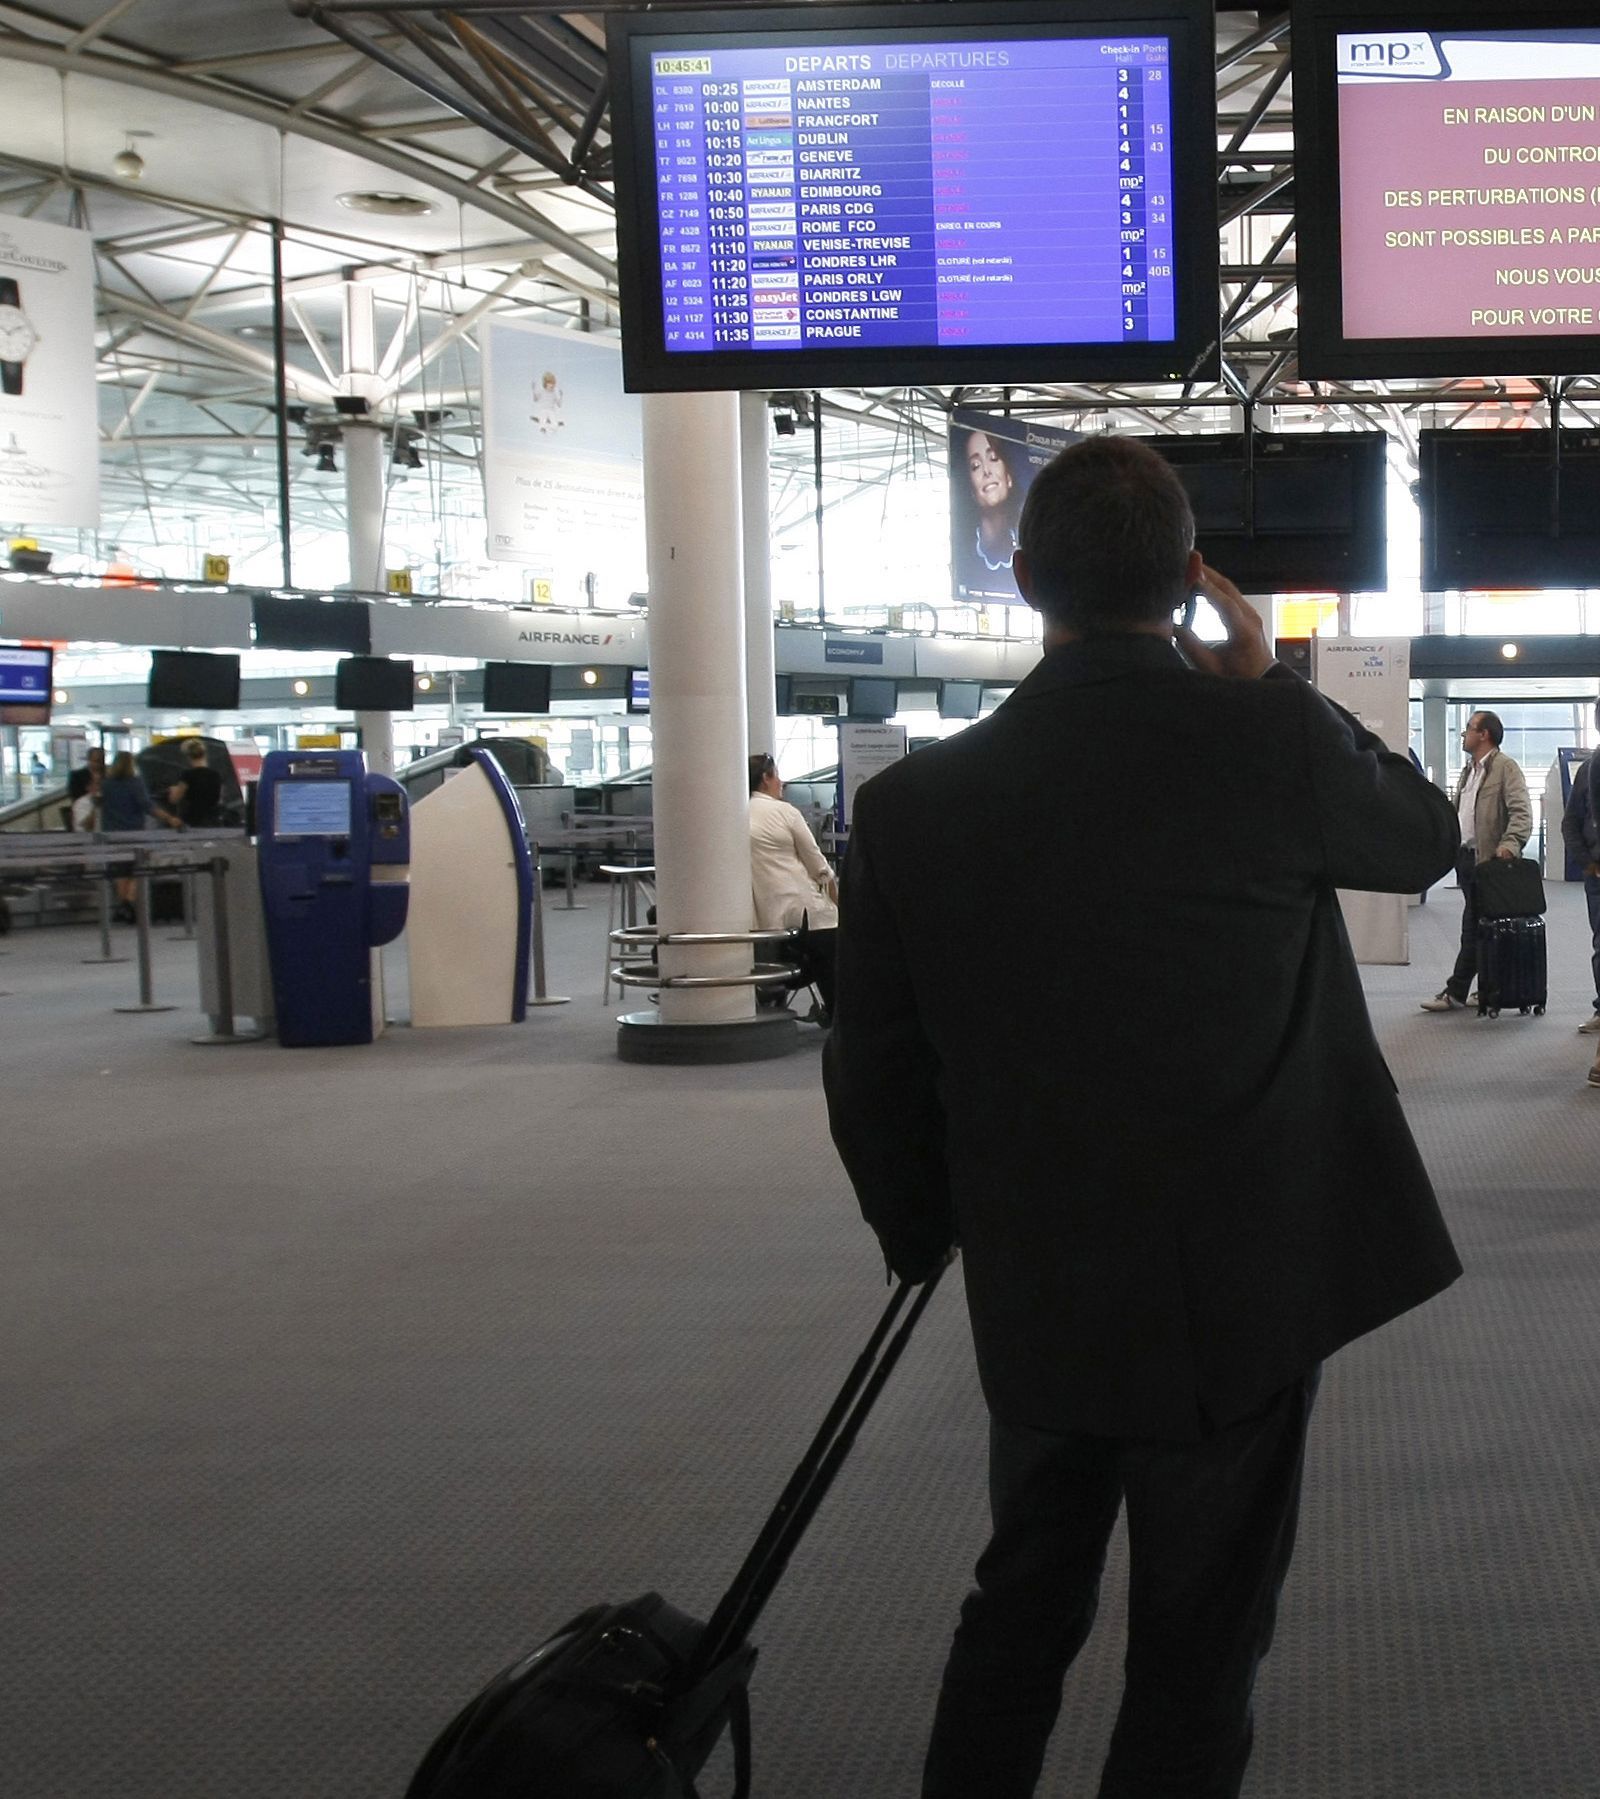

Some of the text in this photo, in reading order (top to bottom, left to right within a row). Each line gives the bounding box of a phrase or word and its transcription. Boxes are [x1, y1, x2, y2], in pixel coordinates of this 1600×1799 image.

[655, 45, 1139, 73] 10:45:41 DEPARTS DEPARTURES Check-in
[703, 70, 1162, 95] 09:25 AMSTERDAM 3 28
[704, 87, 1128, 113] 10:00 NANTES 4
[705, 106, 1126, 131] 10:10 FRANCFORT 1
[1444, 109, 1468, 124] EN
[1475, 107, 1544, 123] RAISON
[1552, 106, 1594, 121] D'UN
[706, 123, 1127, 149] 10:15 DUBLIN 1
[707, 141, 1129, 166] 10:20 GENEVE 4
[1485, 149, 1510, 163] DU
[707, 159, 1130, 184] 10:30 BIARRITZ 4
[708, 185, 881, 201] 10:40 RYANAIR EDIMBOURG
[1385, 191, 1422, 206] DES
[1429, 188, 1584, 205] PERTURBATIONS
[709, 194, 1130, 219] 10:50 PARIS CDG 4
[710, 212, 1130, 236] 11:10 ROME FCO 3
[711, 237, 910, 254] 11:10 RYANAIR VENISE-TREVISE
[1386, 231, 1436, 247] SONT
[1442, 229, 1544, 245] POSSIBLES
[1550, 229, 1562, 243] A
[711, 260, 745, 271] 11:20
[804, 256, 866, 268] LONDRES
[871, 255, 896, 266] LHR
[1123, 248, 1130, 259] 1
[712, 265, 1170, 289] 11:20 PARIS ORLY 4 40B
[1497, 269, 1548, 284] NOUS
[713, 290, 901, 306] 11:25 easyJet LONDRES LGW
[714, 312, 748, 323] 11:30
[806, 308, 898, 320] CONSTANTINE
[1125, 300, 1131, 312] 1
[1472, 310, 1524, 325] POUR
[1530, 309, 1592, 324] VOTRE
[715, 318, 1133, 341] 11:35 PRAGUE 3
[209, 559, 227, 576] 10
[395, 575, 407, 587] 11
[536, 584, 549, 598] 12
[518, 631, 600, 645] AIRFRANCE
